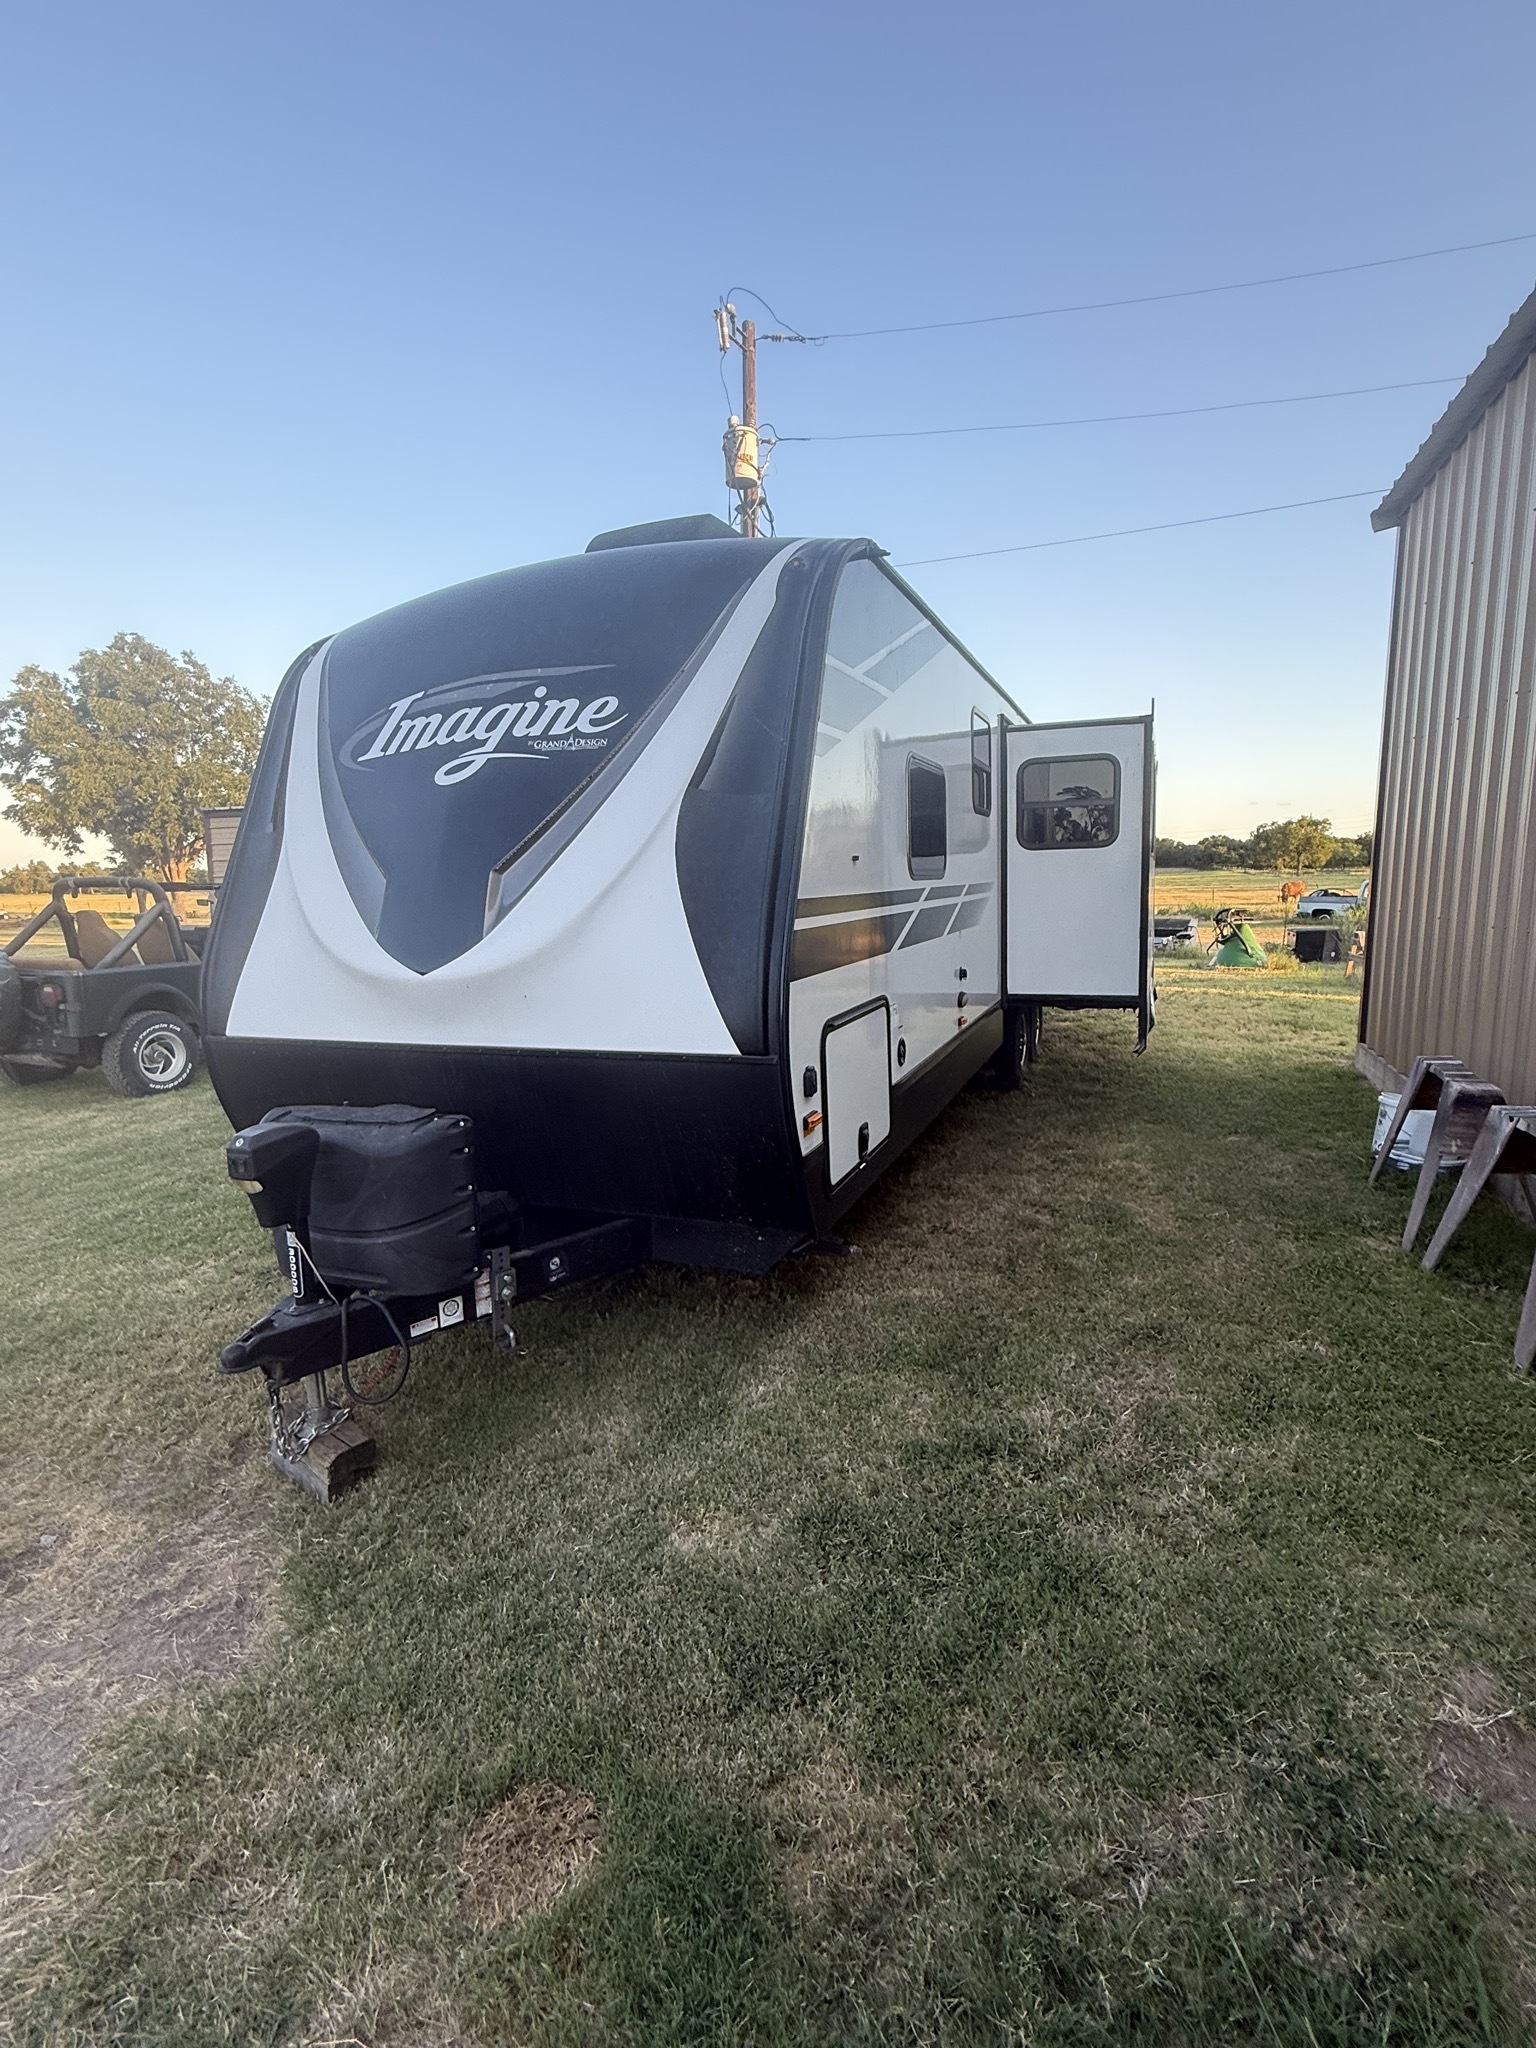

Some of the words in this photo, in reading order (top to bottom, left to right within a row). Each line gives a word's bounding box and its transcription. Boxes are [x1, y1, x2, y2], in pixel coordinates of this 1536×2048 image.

[357, 686, 629, 786] Imagine
[534, 740, 567, 749] GRAND
[575, 738, 608, 747] DESIGN
